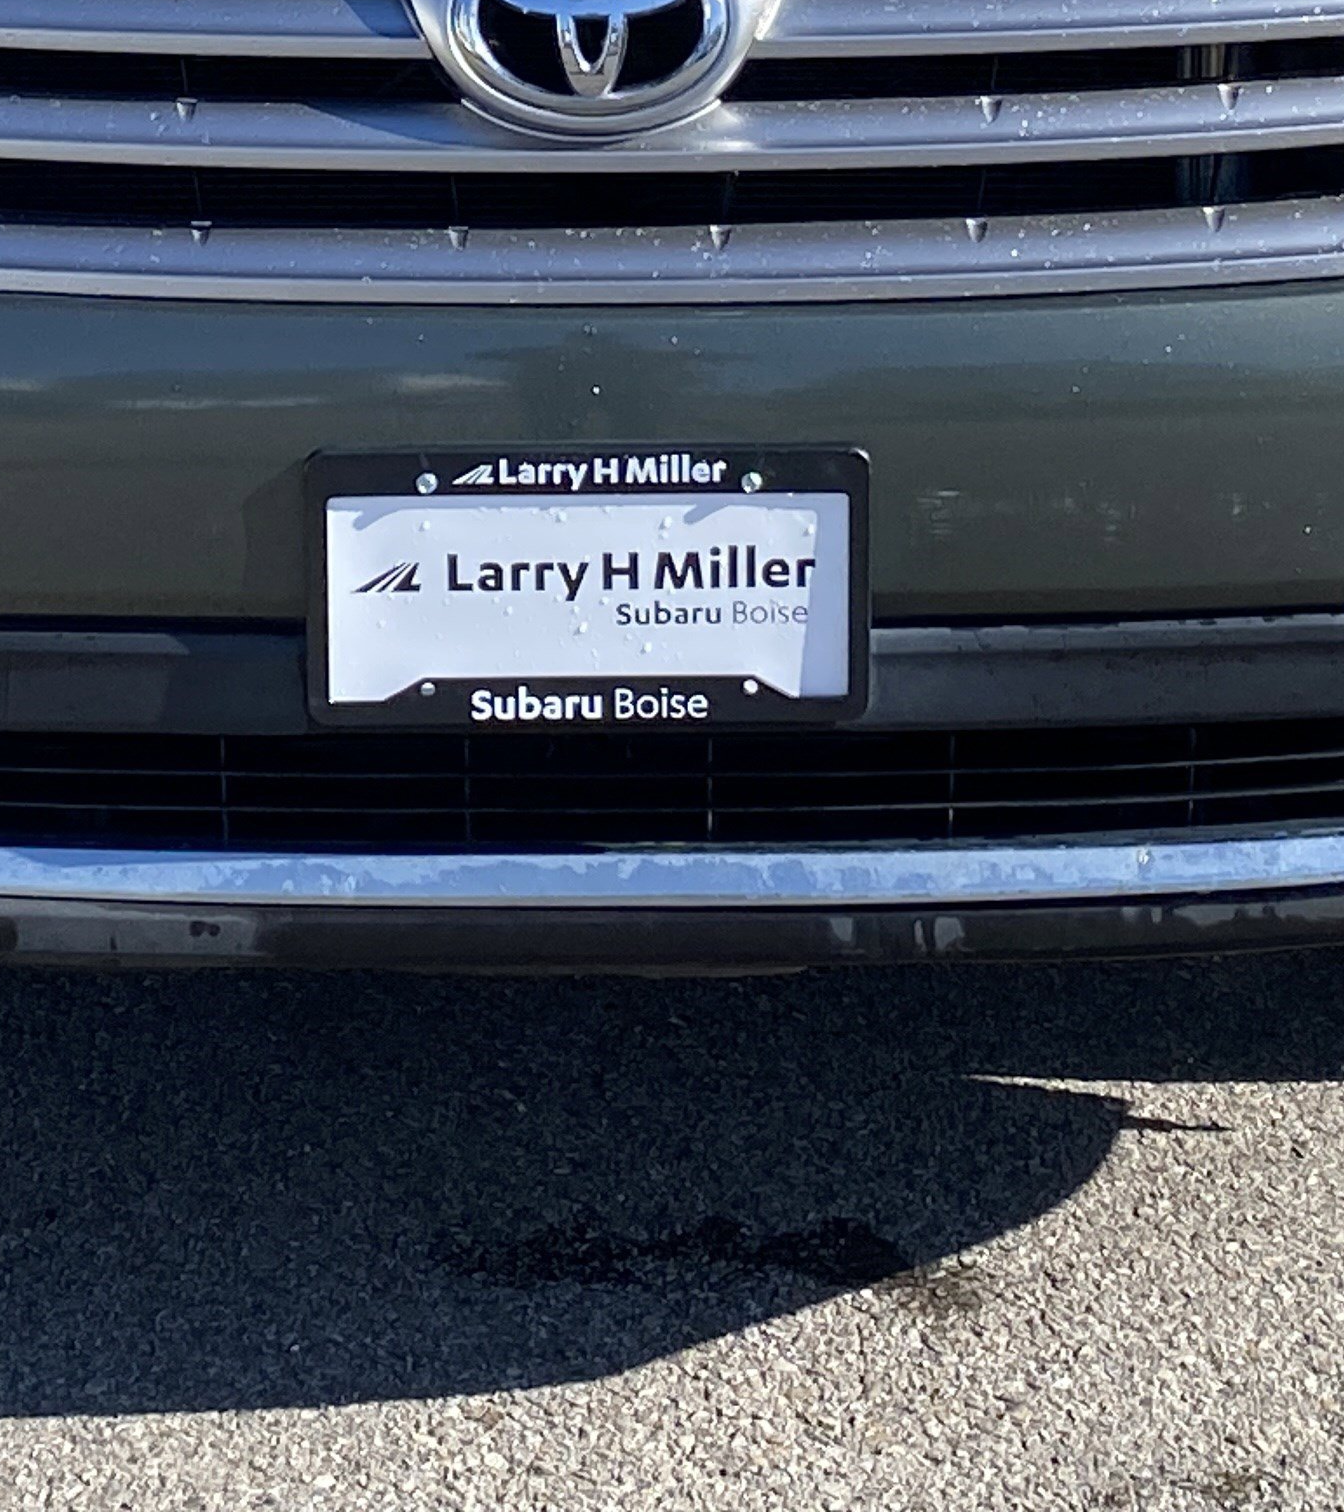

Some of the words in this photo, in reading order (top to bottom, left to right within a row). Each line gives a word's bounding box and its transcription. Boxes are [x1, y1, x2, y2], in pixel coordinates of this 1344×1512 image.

[498, 457, 588, 492] Larry
[593, 457, 619, 484] H
[625, 453, 727, 484] Miller
[446, 552, 589, 602] Larry
[602, 551, 640, 591] H
[653, 544, 816, 590] Miller
[615, 600, 722, 626] Subaru
[731, 599, 809, 625] Boise
[470, 685, 604, 721] Subaru
[613, 687, 708, 720] Boise
